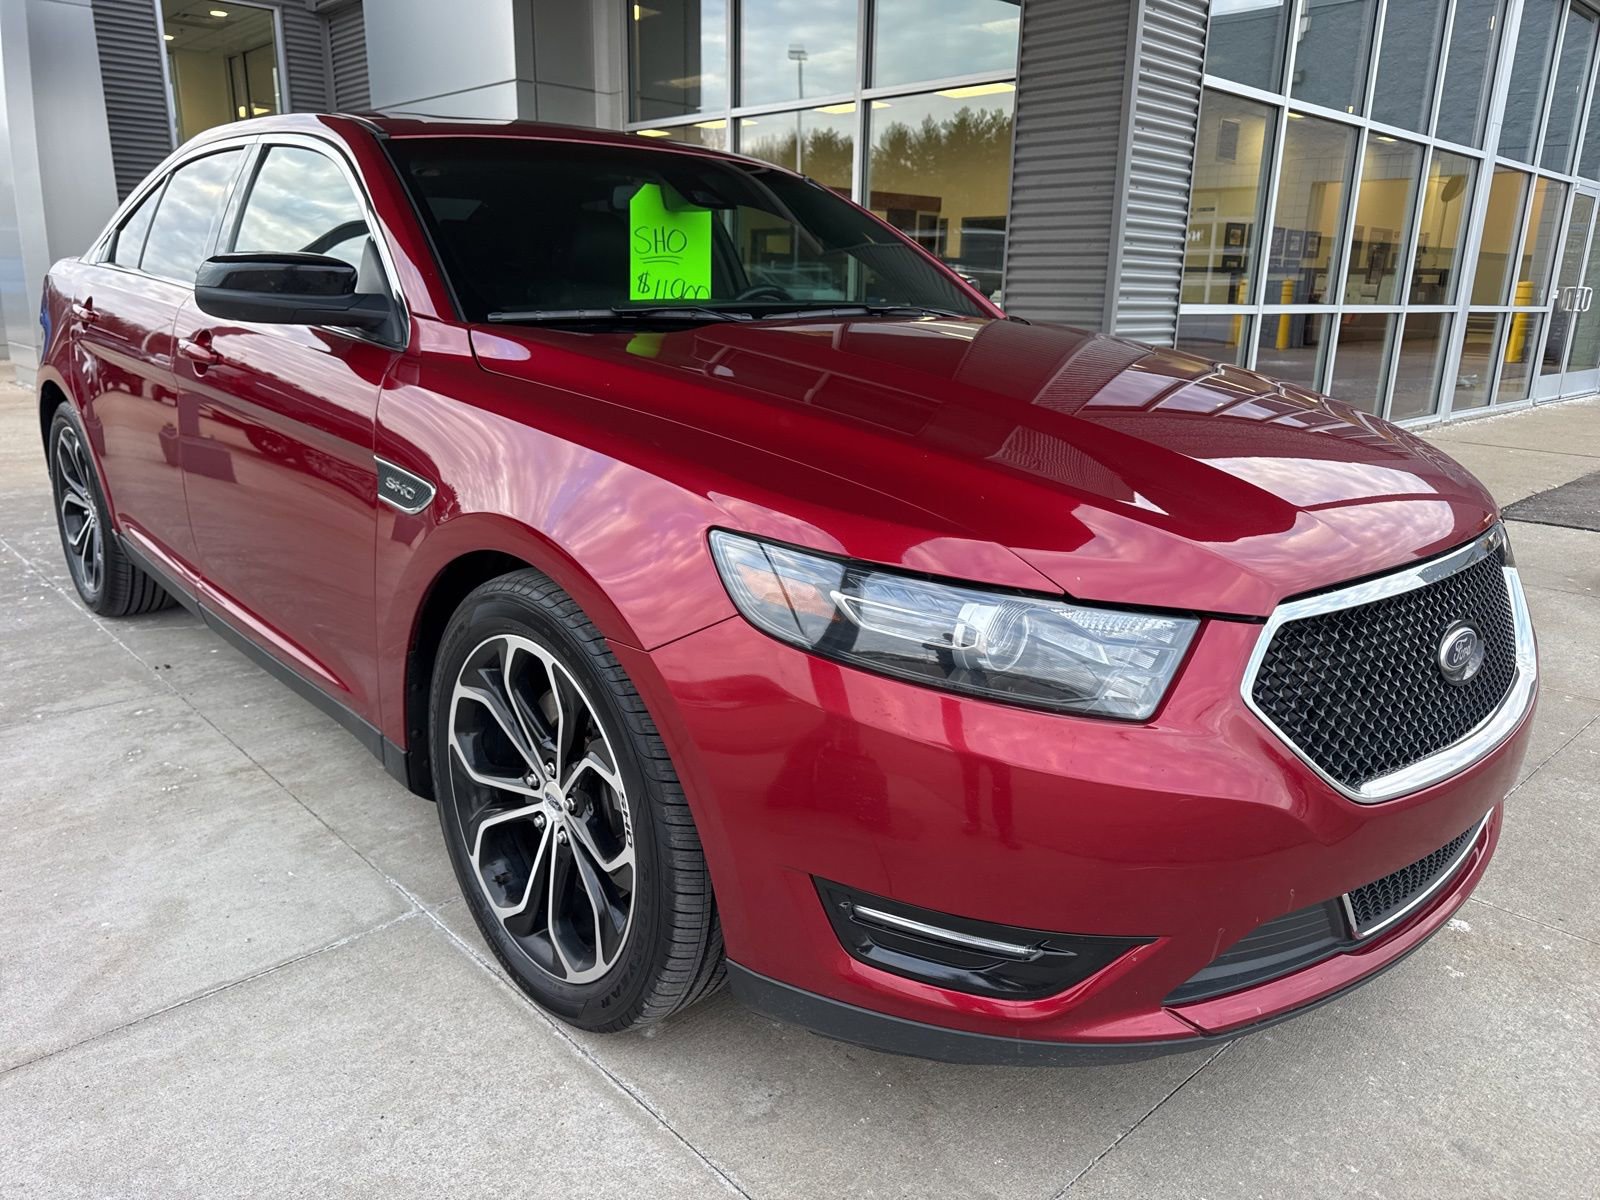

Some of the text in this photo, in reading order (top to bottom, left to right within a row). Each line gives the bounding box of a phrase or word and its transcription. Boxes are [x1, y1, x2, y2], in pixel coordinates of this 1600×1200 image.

[634, 226, 687, 254] SHO
[385, 476, 416, 500] SHO
[619, 790, 633, 849] SHO
